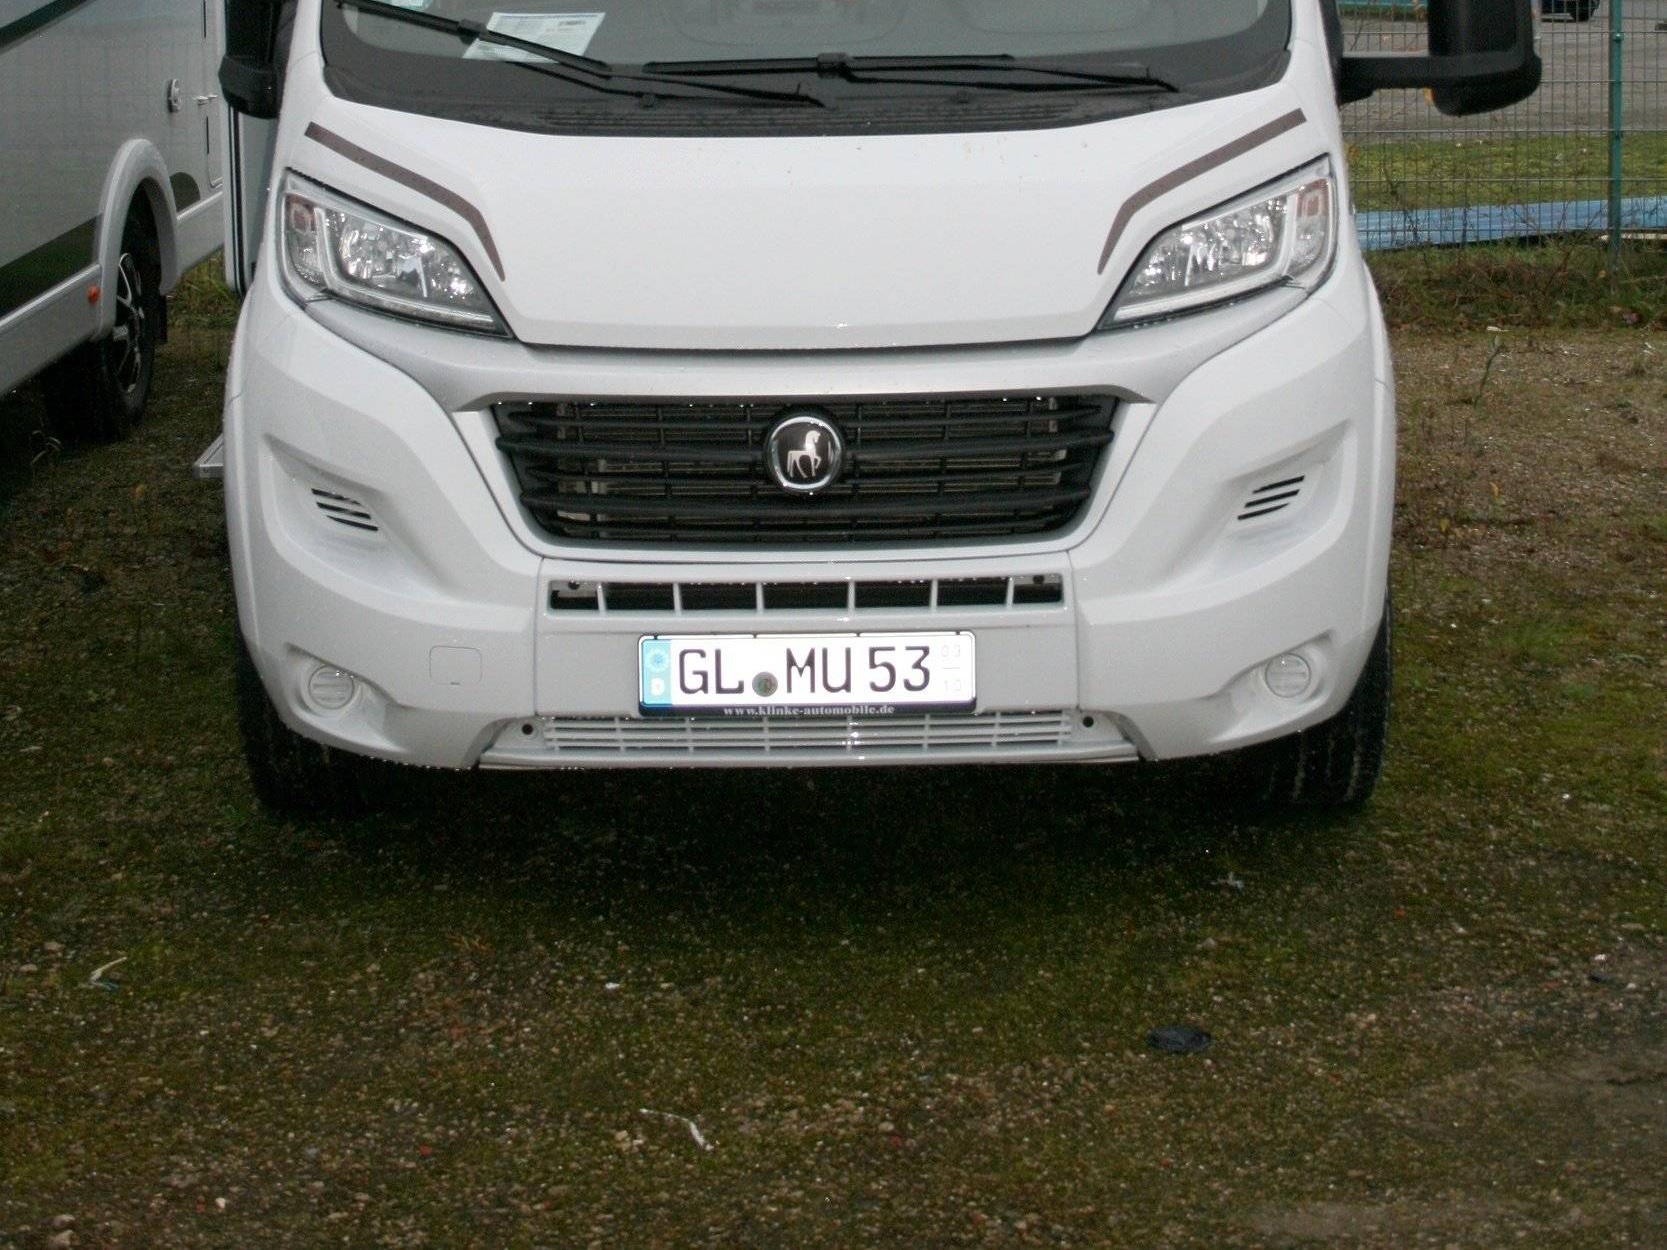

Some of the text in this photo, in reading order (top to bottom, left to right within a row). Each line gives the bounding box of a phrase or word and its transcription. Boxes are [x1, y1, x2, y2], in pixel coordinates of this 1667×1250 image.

[678, 645, 931, 695] GL MU 53
[723, 704, 895, 716] www.klinke-automobile.de
